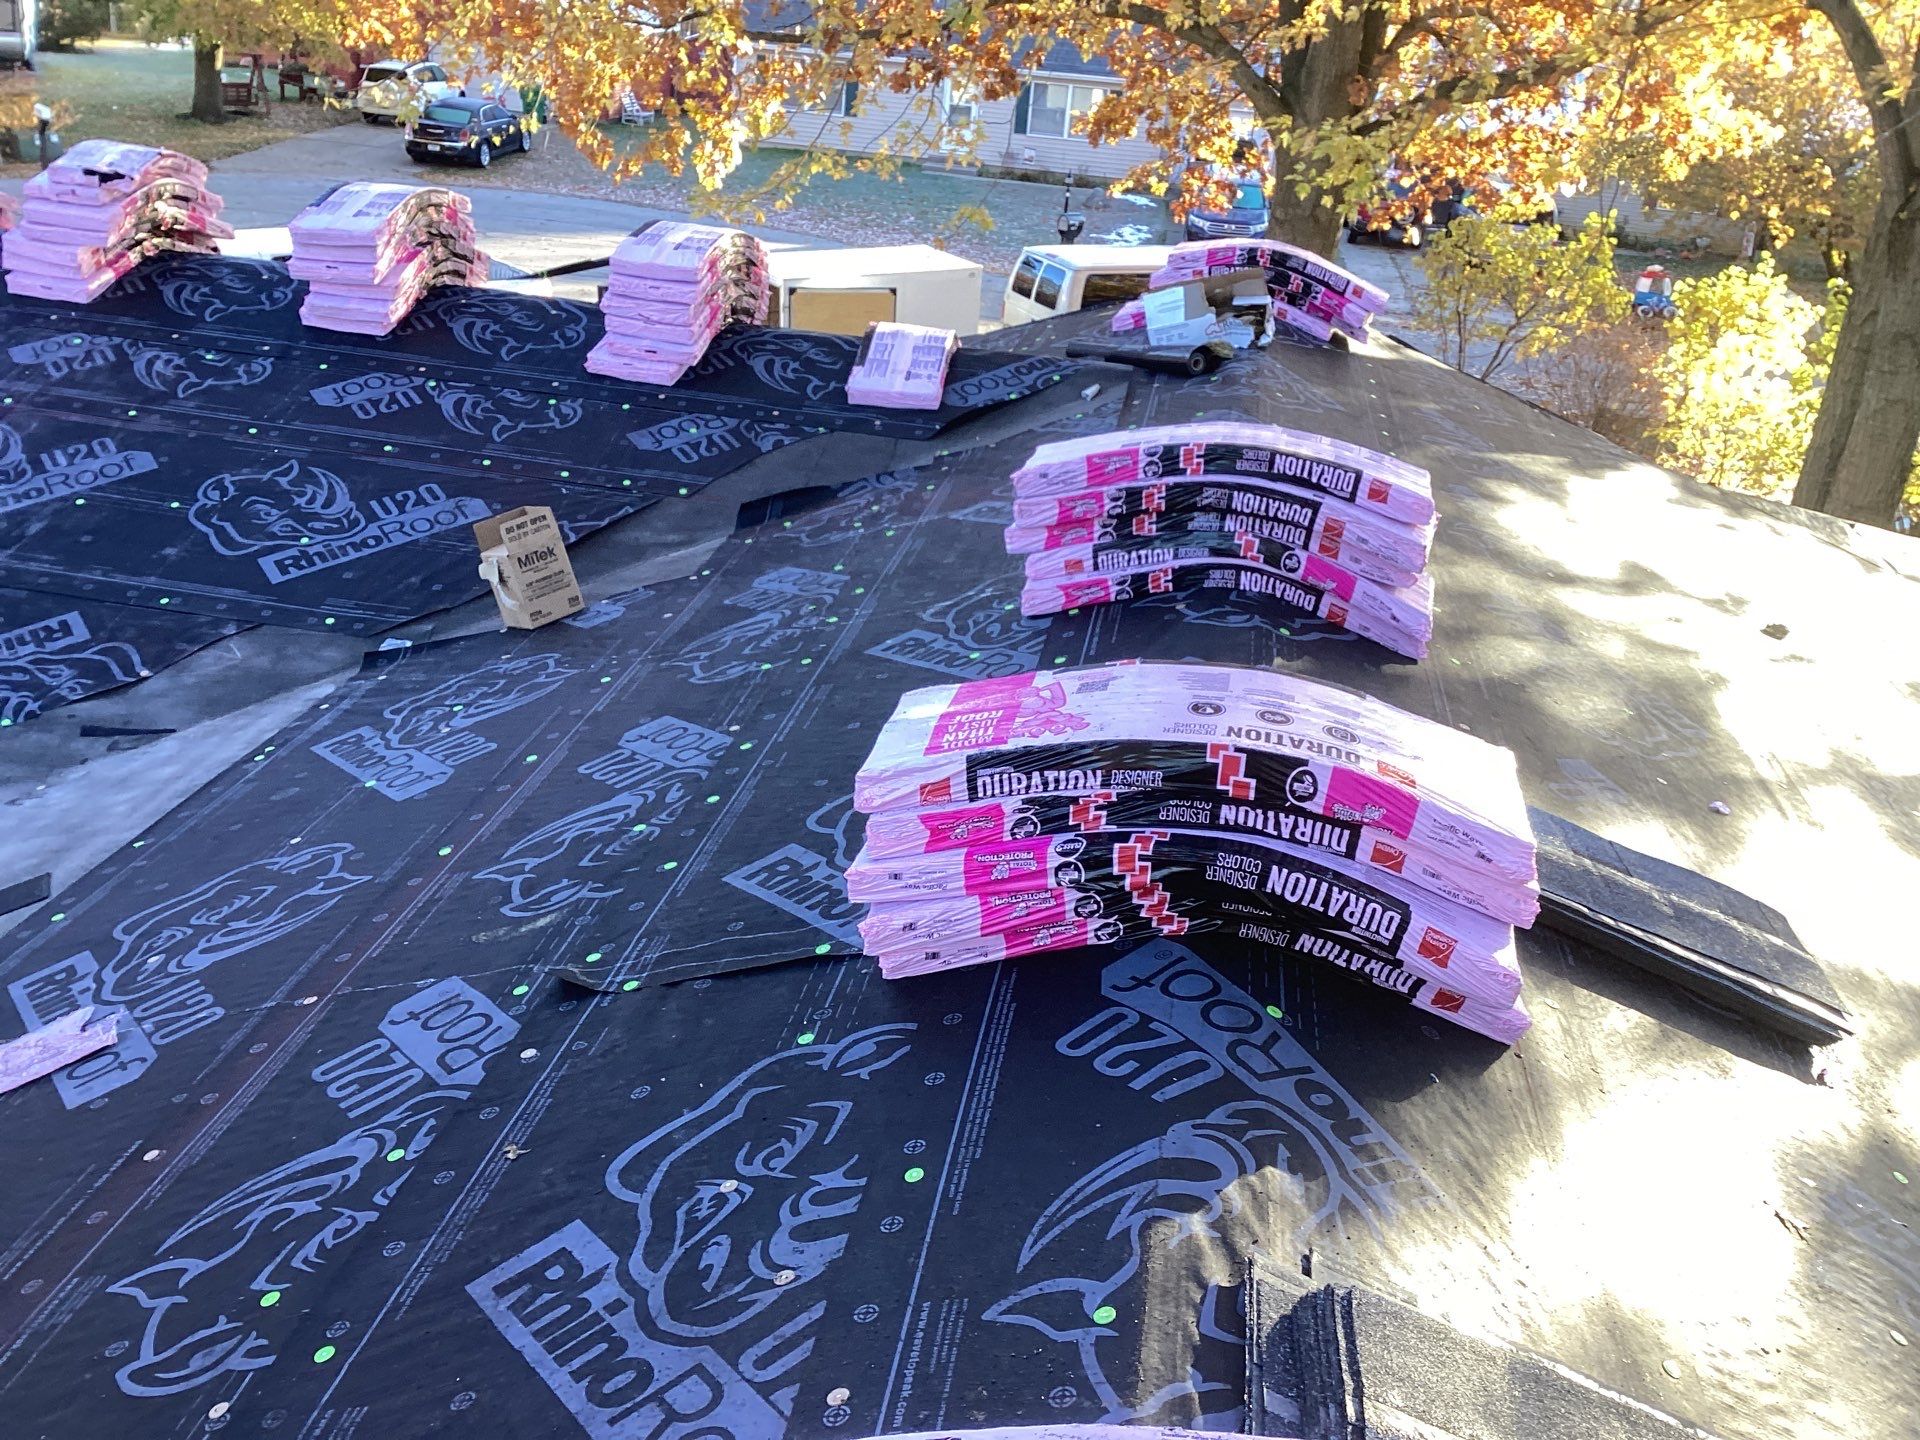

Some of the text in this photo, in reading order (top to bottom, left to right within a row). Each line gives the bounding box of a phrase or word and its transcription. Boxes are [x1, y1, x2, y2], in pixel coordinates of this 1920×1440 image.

[1305, 261, 1348, 292] DURATION
[351, 387, 423, 420] U20
[40, 437, 117, 472] U20
[671, 431, 742, 464] U20
[1274, 453, 1356, 493] DURATION
[369, 483, 447, 519] U20
[1231, 490, 1313, 526] DURATION
[273, 500, 474, 576] RhinoRoof
[505, 514, 547, 535] DO NOT OPEN
[1224, 513, 1307, 546] DURATION
[517, 546, 557, 569] MiTek
[1098, 548, 1173, 570] DURATION
[1239, 569, 1316, 612] DURATION
[324, 733, 448, 791] RhinoRoof
[422, 731, 497, 765] U20
[1227, 725, 1361, 766] DURATION
[577, 750, 664, 788] U20
[977, 769, 1163, 798] DURATION DESIGNER
[1159, 807, 1209, 824] DESIGNER
[1219, 804, 1351, 854] DURATION
[977, 851, 1034, 862] PROTECTION
[1217, 852, 1262, 874] COLORS
[1205, 864, 1258, 890] DESIGNER
[1266, 864, 1402, 940] DURATION
[1238, 922, 1419, 994] DURATION DESIGNER
[133, 979, 225, 1045] U20
[388, 992, 503, 1075] Roof
[1054, 1006, 1224, 1103] U20
[311, 1038, 424, 1118] U20
[893, 1301, 931, 1428] www.eavetopeak.com
